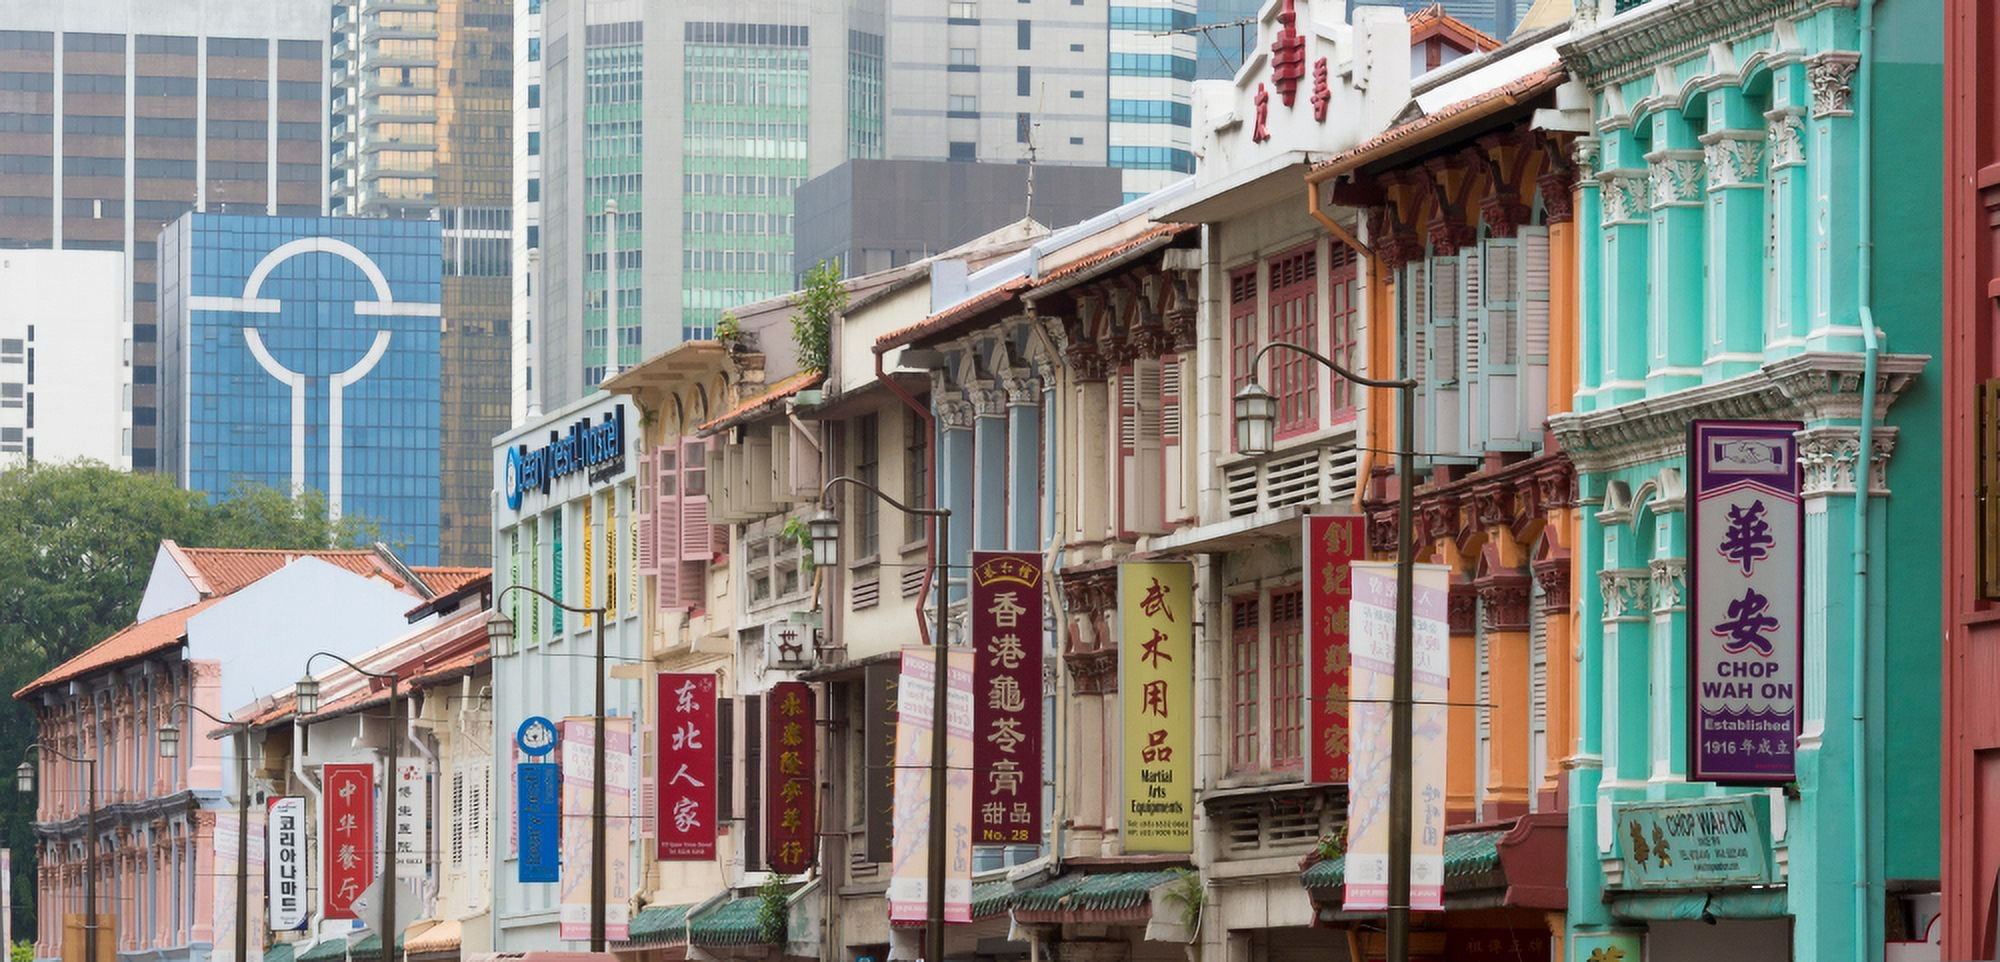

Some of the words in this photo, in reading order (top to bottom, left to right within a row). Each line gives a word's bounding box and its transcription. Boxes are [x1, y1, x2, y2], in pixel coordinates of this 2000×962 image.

[1712, 499, 1780, 655] 華安
[1139, 577, 1175, 764] 武术用品
[1717, 661, 1779, 678] CHOP
[987, 591, 1027, 797] 香港龜苓膏
[1703, 682, 1753, 700] WAH
[1761, 682, 1794, 699] ON
[1704, 717, 1791, 732] Established
[669, 679, 705, 832] 东北人家
[1704, 740, 1737, 755] 1916
[1740, 739, 1791, 756] 年成立
[1141, 769, 1173, 783] Martial
[1148, 785, 1167, 798] Arts
[982, 801, 1031, 825] 甜品
[1131, 799, 1182, 815] Equipments
[1666, 812, 1695, 837] CHOP
[1697, 808, 1728, 836] WAH
[1729, 809, 1748, 834] ON
[336, 779, 362, 901] 中华餐厅
[983, 829, 1007, 842] No.
[1011, 829, 1029, 842] 28
